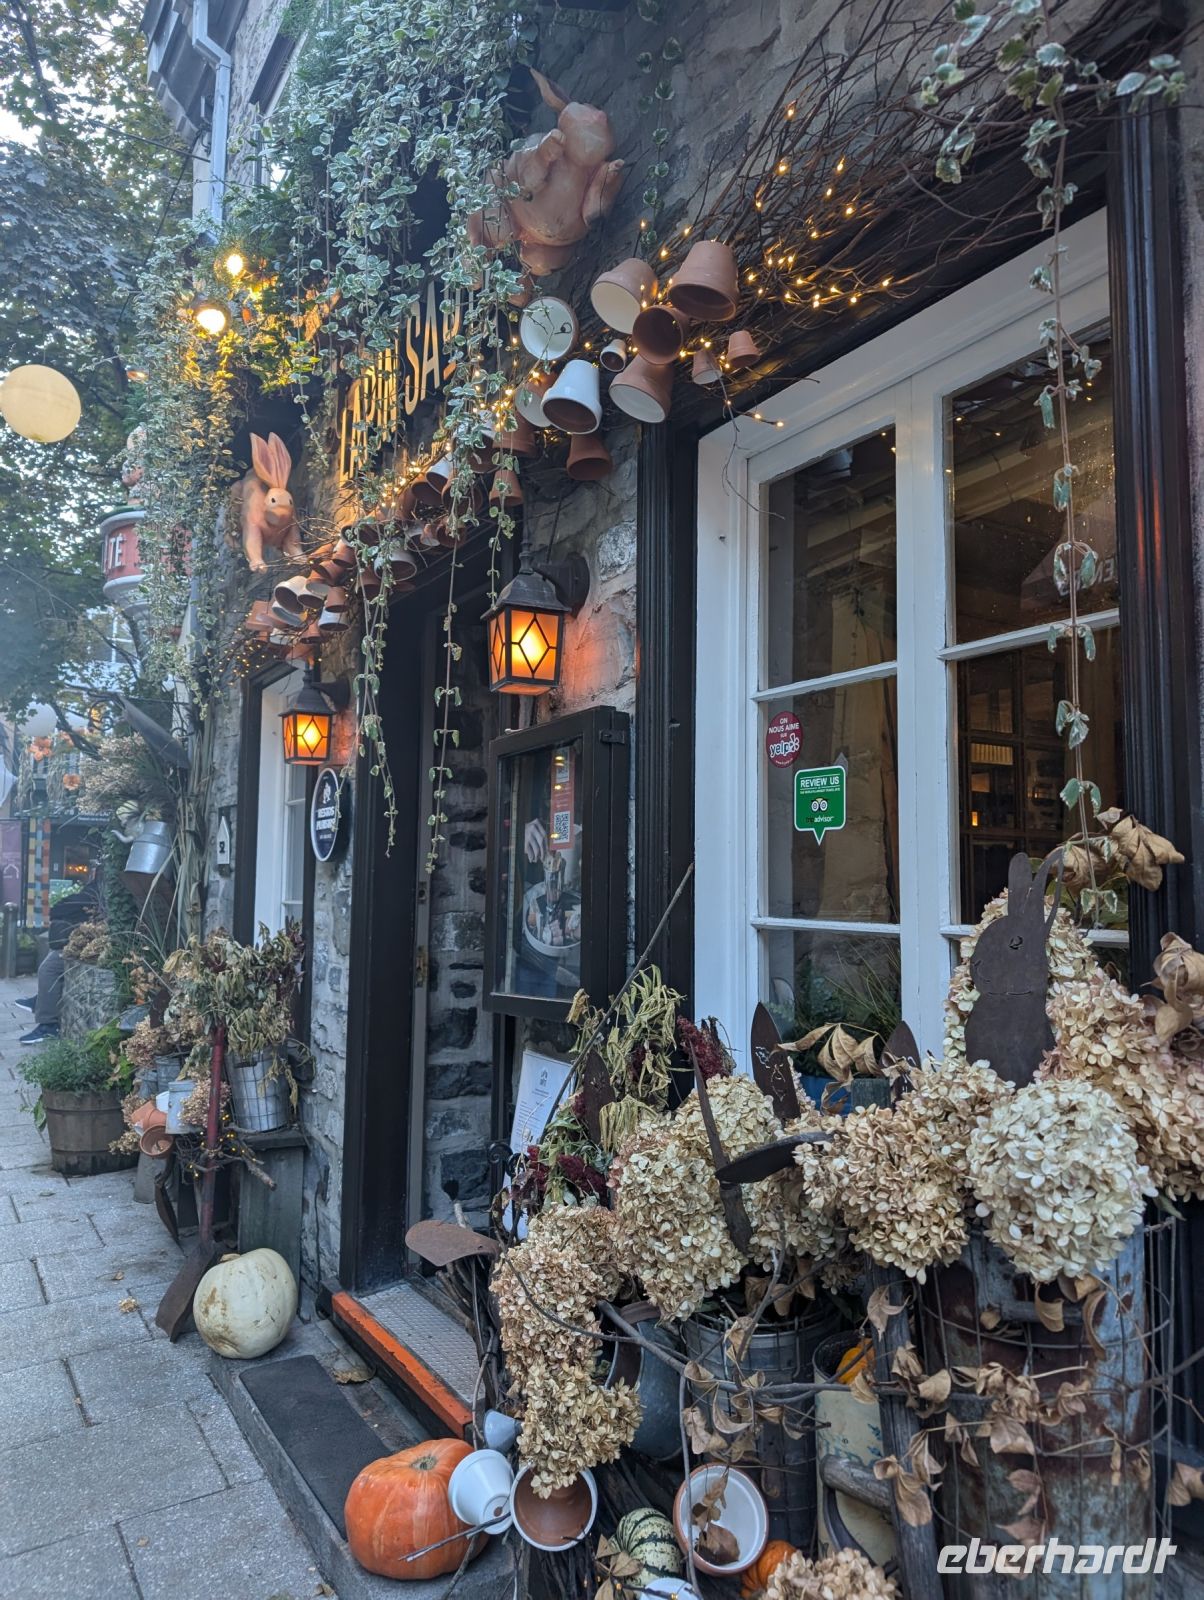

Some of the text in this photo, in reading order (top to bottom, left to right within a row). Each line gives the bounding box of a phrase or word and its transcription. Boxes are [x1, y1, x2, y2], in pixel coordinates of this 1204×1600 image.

[769, 722, 800, 734] NOUS AIME
[770, 739, 795, 758] yelp
[800, 776, 840, 788] REVIEW US
